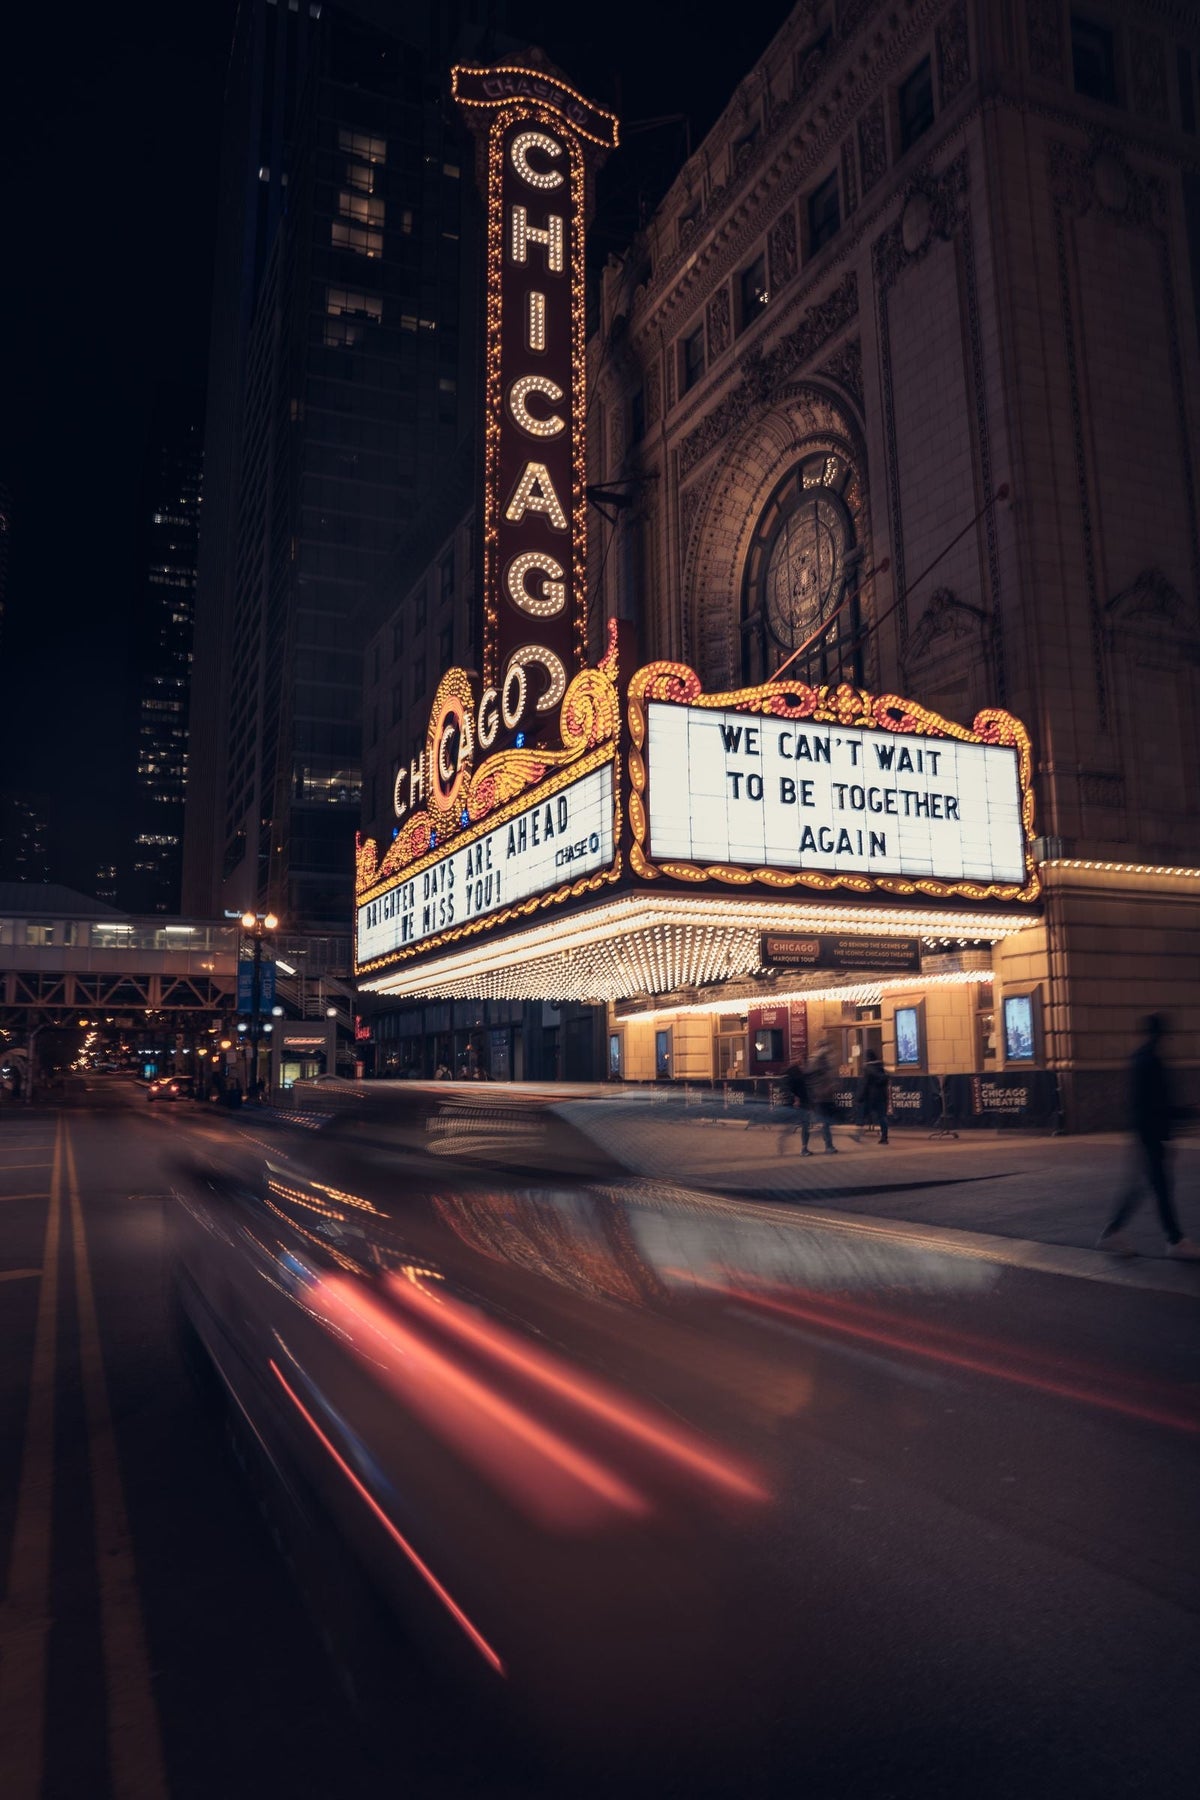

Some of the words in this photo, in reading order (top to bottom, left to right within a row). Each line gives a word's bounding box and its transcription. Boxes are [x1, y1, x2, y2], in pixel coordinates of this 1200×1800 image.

[482, 79, 565, 106] CHASE
[507, 131, 568, 711] CHICAGO
[394, 663, 527, 817] CHICAGO
[718, 723, 759, 756] WE
[778, 732, 862, 767] CAN'T
[873, 742, 942, 776] WAIT
[727, 771, 765, 802] TO
[780, 776, 815, 808] BE
[832, 782, 960, 821] TOGETHER
[555, 842, 589, 868] CHASE
[799, 824, 888, 858] AGAIN
[365, 880, 416, 931] BRIGHTER
[423, 857, 455, 903] DAYS
[465, 835, 493, 881] ARE
[507, 794, 569, 860] AHEAD
[401, 910, 414, 942] WE
[422, 894, 455, 935] MISS
[465, 869, 503, 914] YOU!
[773, 943, 814, 953] CHICAGO
[892, 1092, 921, 1100] CHICAGO
[892, 1100, 921, 1108] THEATRE
[981, 1088, 1026, 1098] CHICAGO
[982, 1098, 1026, 1107] THEATRE
